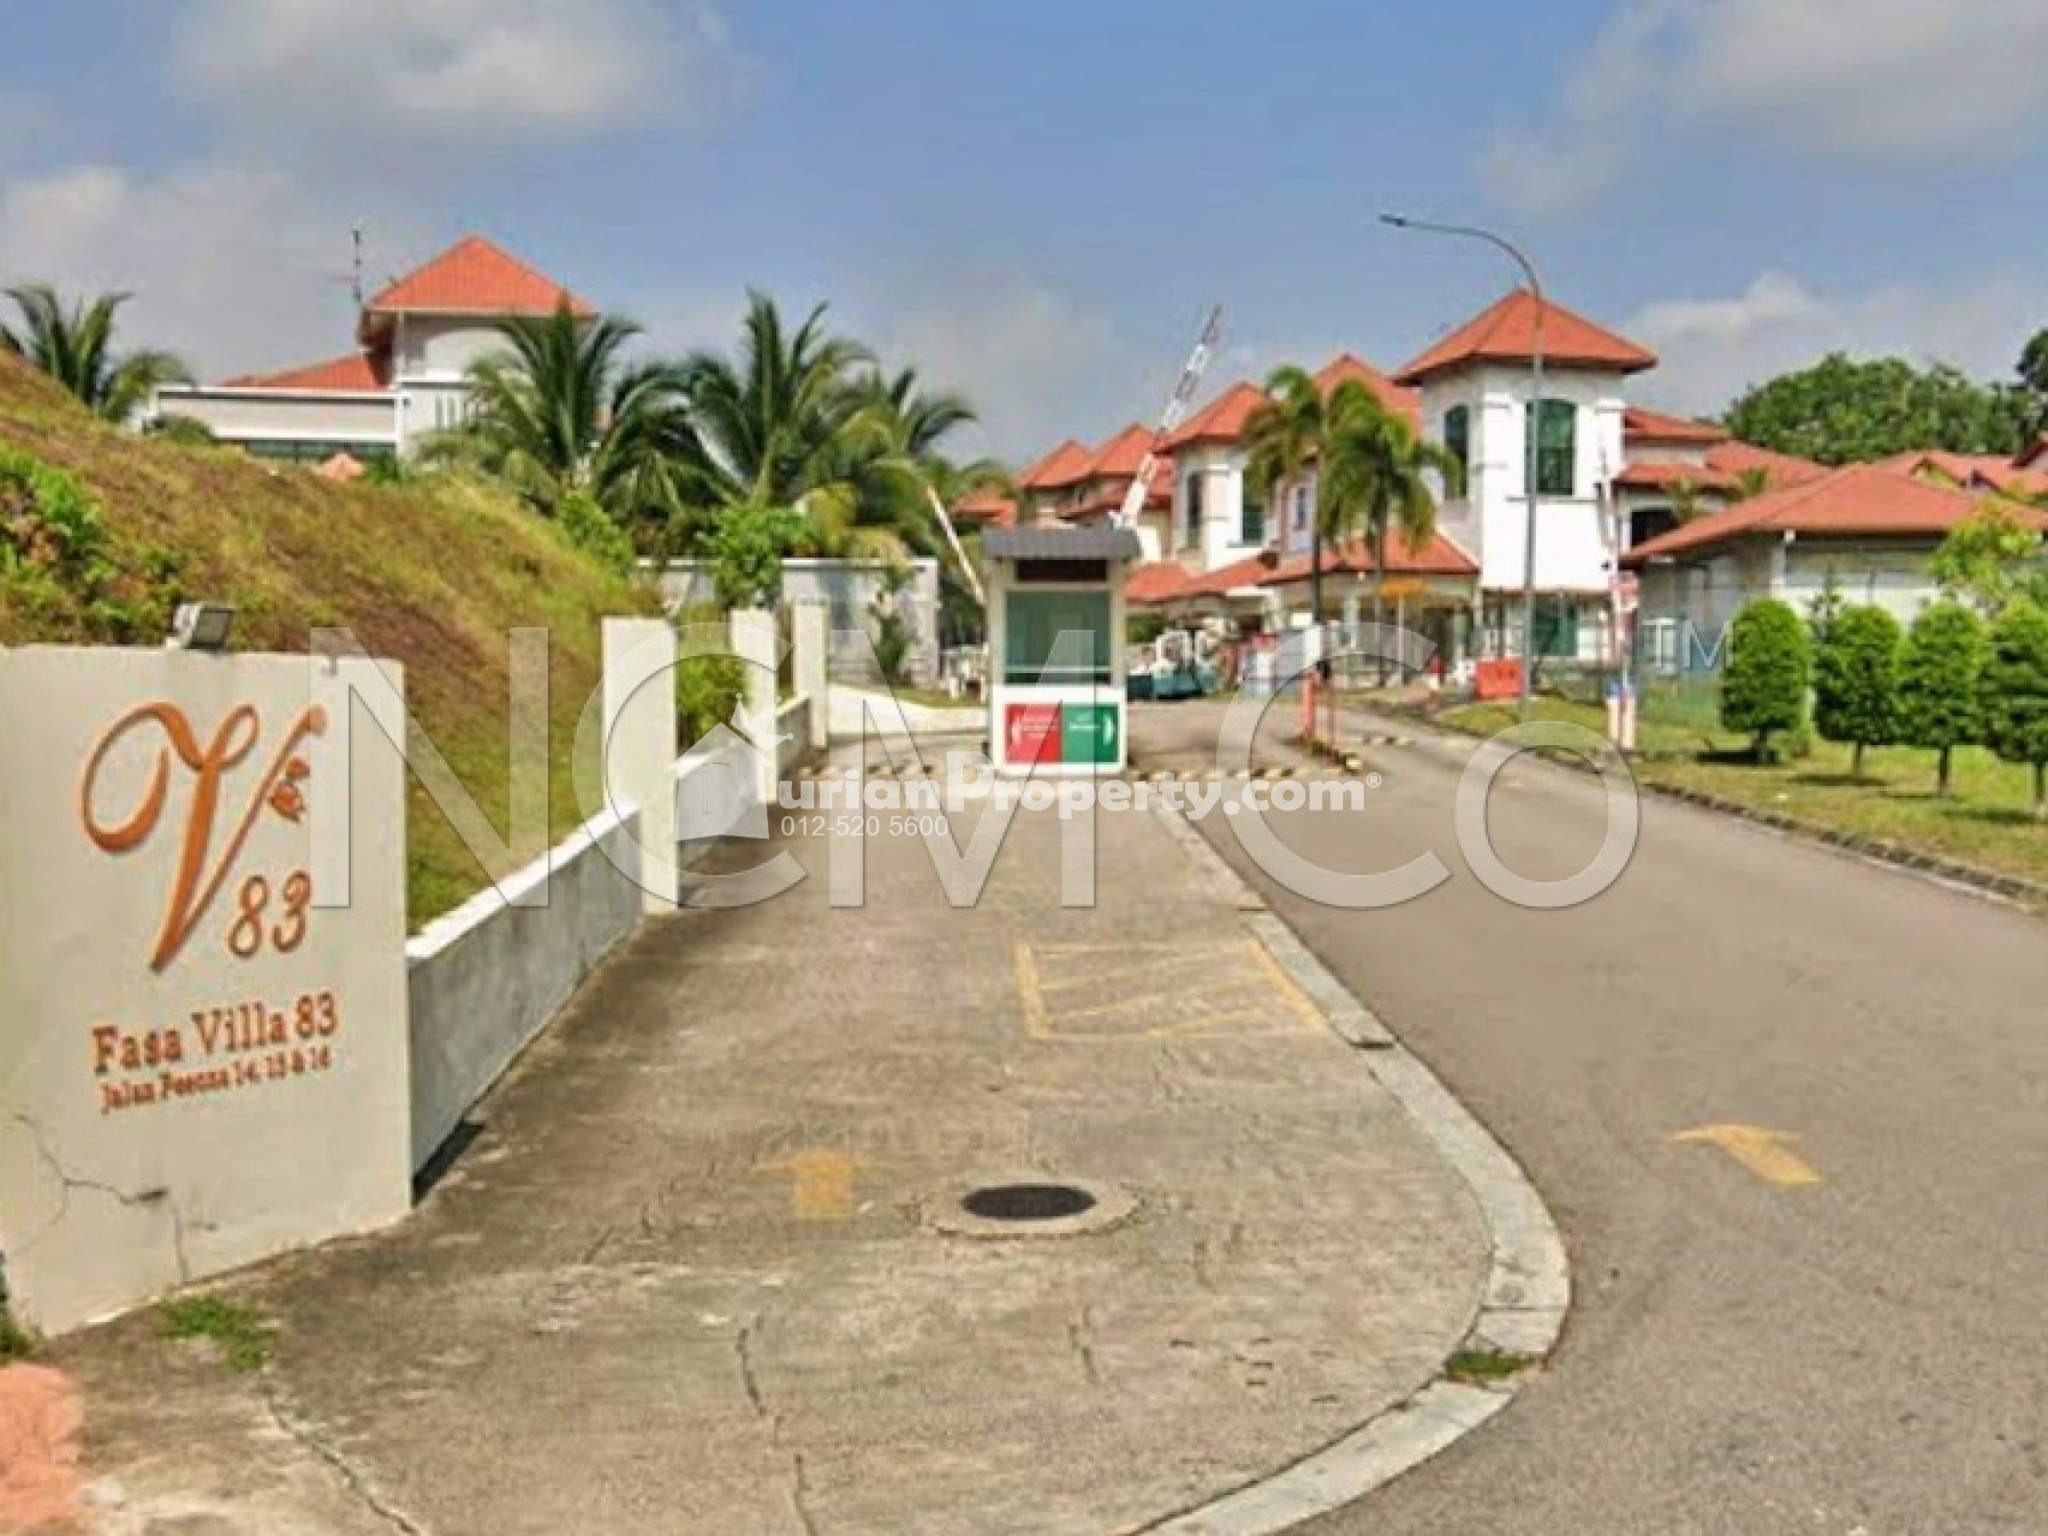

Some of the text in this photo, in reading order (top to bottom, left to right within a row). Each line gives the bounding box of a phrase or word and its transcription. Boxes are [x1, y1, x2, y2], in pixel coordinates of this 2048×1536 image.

[228, 869, 312, 959] 83
[92, 991, 337, 1075] Fasa Villa 83
